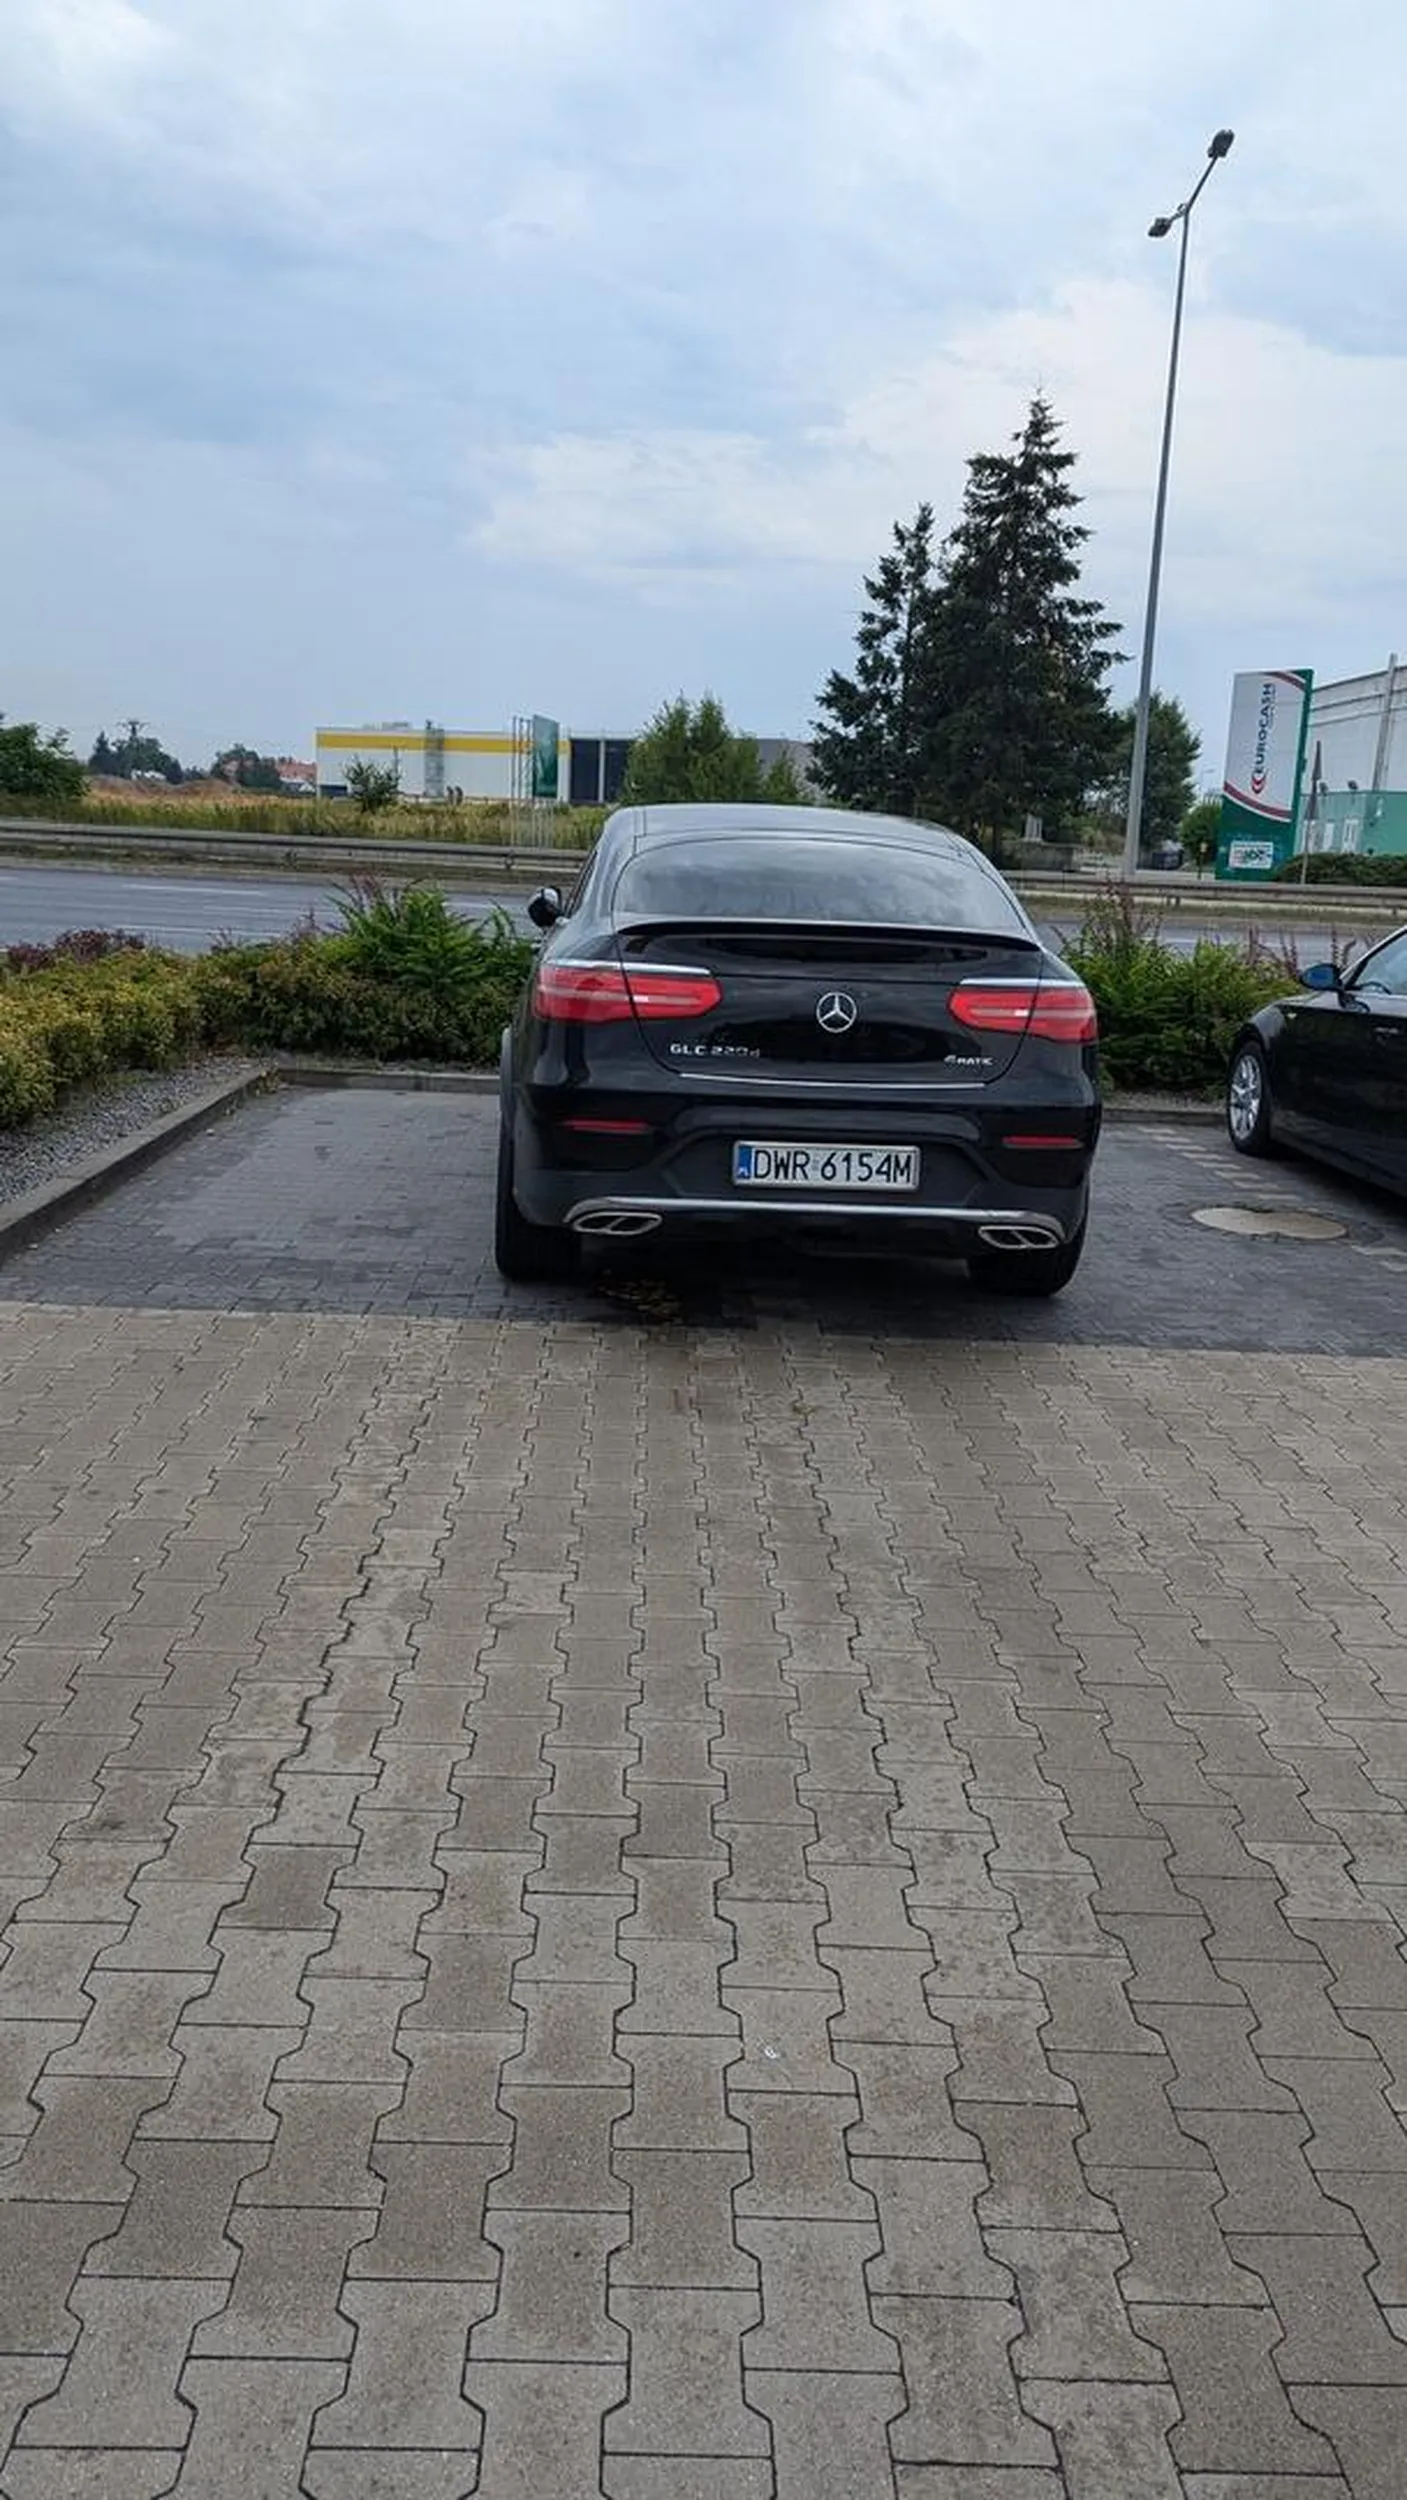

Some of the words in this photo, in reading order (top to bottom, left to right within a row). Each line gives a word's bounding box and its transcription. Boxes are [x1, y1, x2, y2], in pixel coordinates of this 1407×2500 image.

[1255, 683, 1271, 773] EUROCASH
[670, 1043, 706, 1056] GLC
[754, 1150, 811, 1181] DWR
[820, 1152, 912, 1183] 6154M
